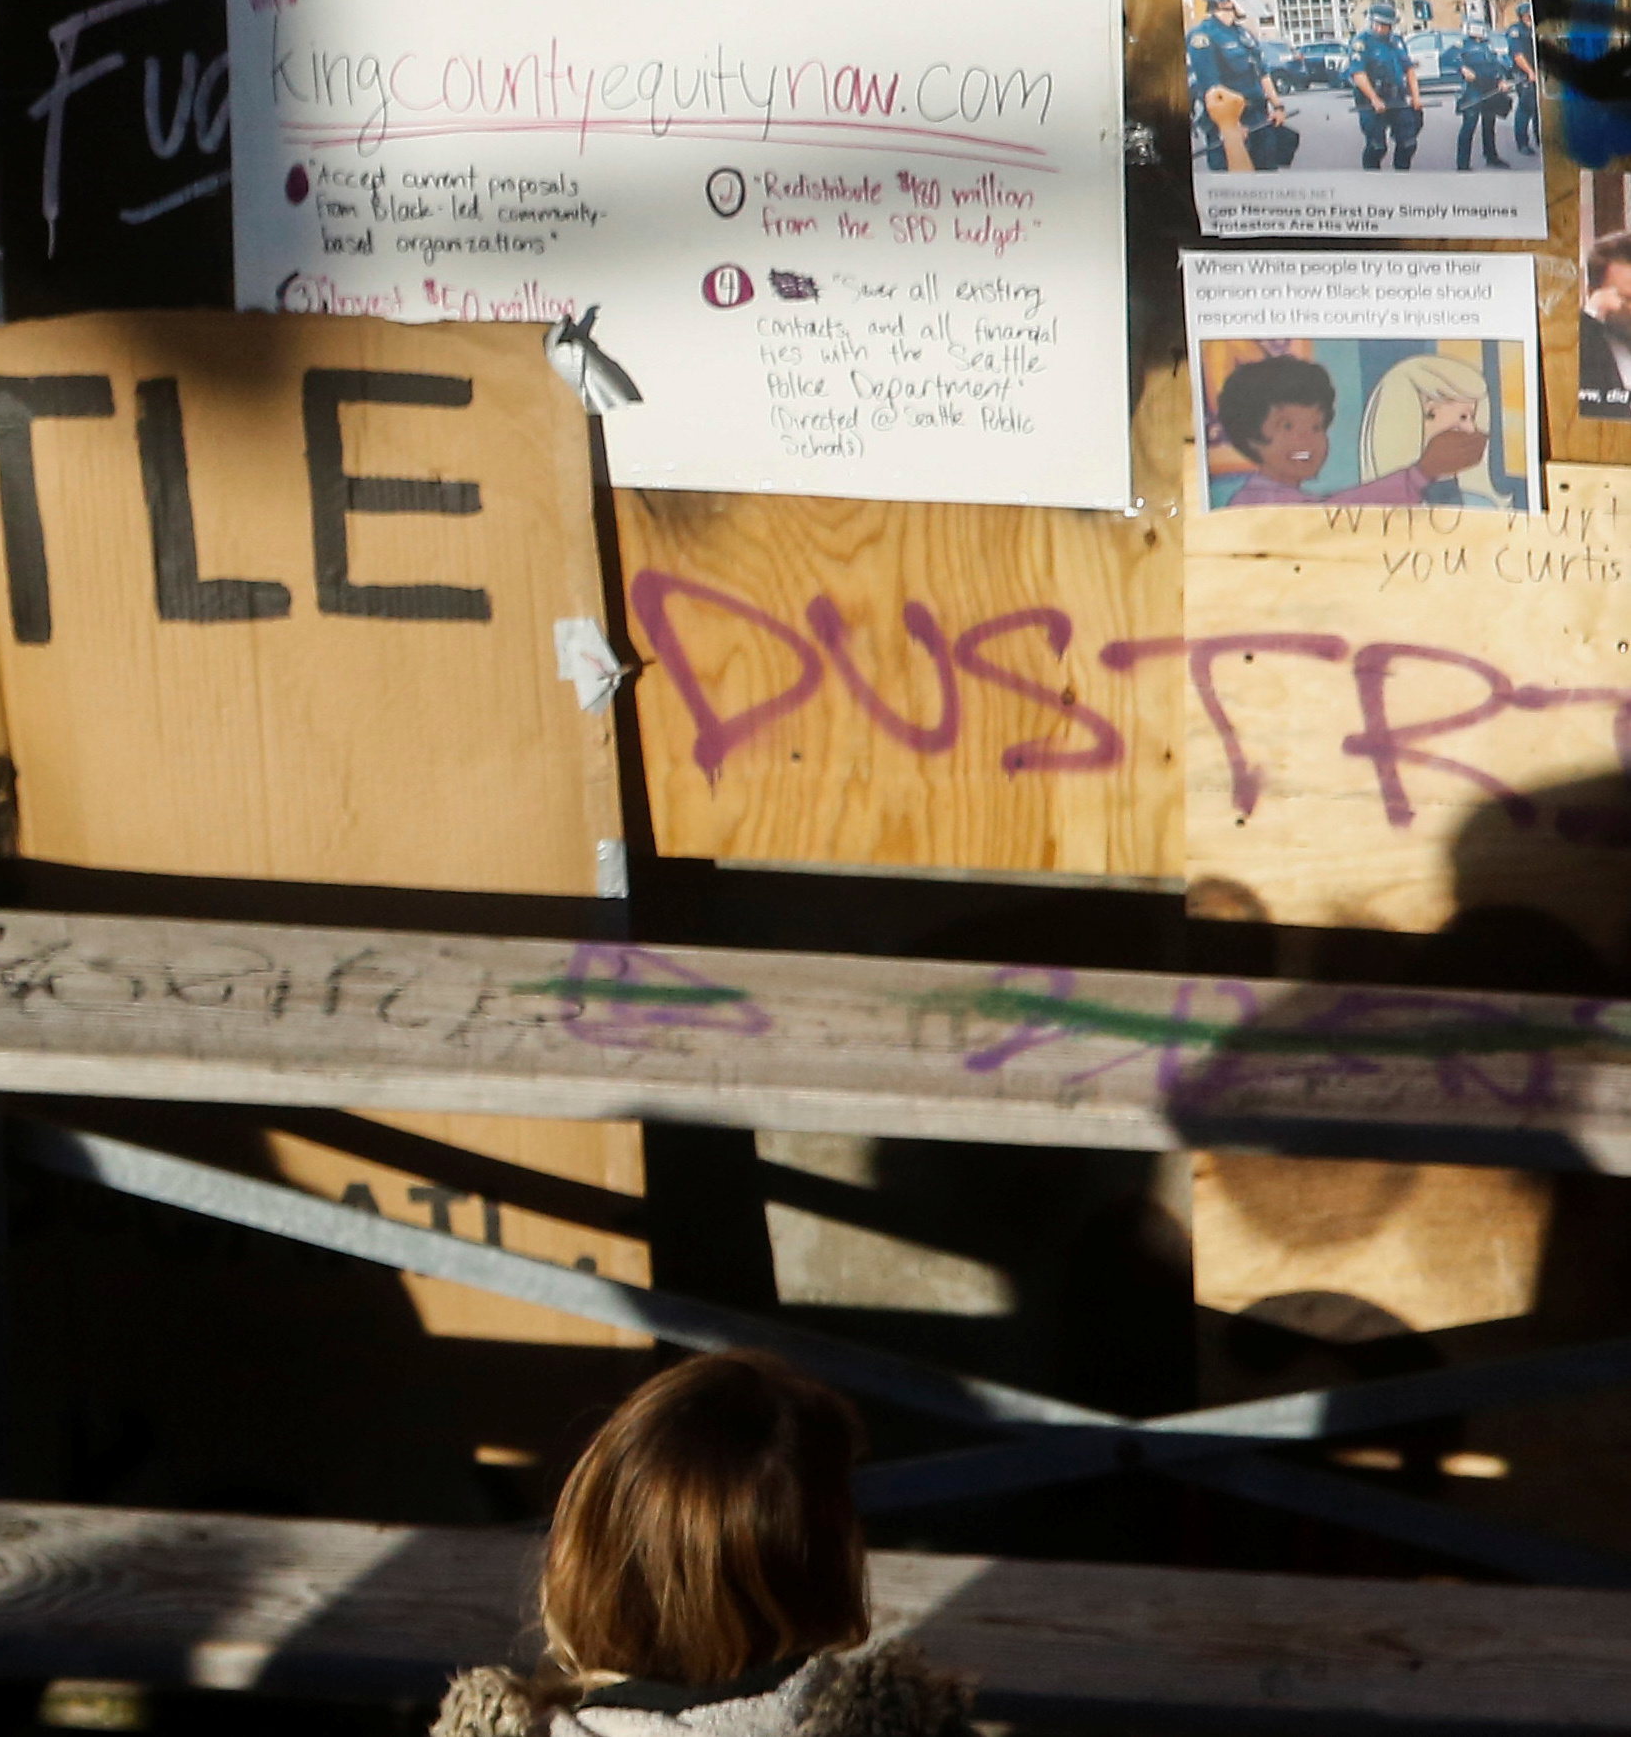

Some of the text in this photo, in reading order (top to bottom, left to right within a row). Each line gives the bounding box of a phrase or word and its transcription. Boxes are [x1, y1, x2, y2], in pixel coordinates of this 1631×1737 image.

[402, 165, 477, 190] current
[488, 173, 579, 202] proposals
[952, 172, 1034, 210] million
[1208, 205, 1518, 221] Cop Nervous On First Day Simply Imagines
[1290, 220, 1314, 232] Are
[1318, 220, 1341, 232] His
[1346, 220, 1379, 232] Wife
[322, 228, 373, 255] based
[838, 214, 874, 240] the
[889, 215, 937, 244] SPD
[1194, 258, 1483, 280] When White people try to give their
[489, 279, 576, 322] million
[910, 272, 940, 305] all
[955, 277, 1046, 319] existing
[1195, 284, 1493, 303] opinion on how Black people should
[867, 315, 905, 336] and
[920, 313, 952, 343] all
[975, 318, 1060, 345] financial
[1196, 309, 1480, 327] respond to this country's injustices
[760, 342, 1047, 375] ties with the Seattle
[767, 372, 829, 400] Police
[870, 408, 898, 431] @
[903, 404, 965, 428] Seattle
[981, 405, 1036, 434] Public
[1379, 547, 1469, 592] you
